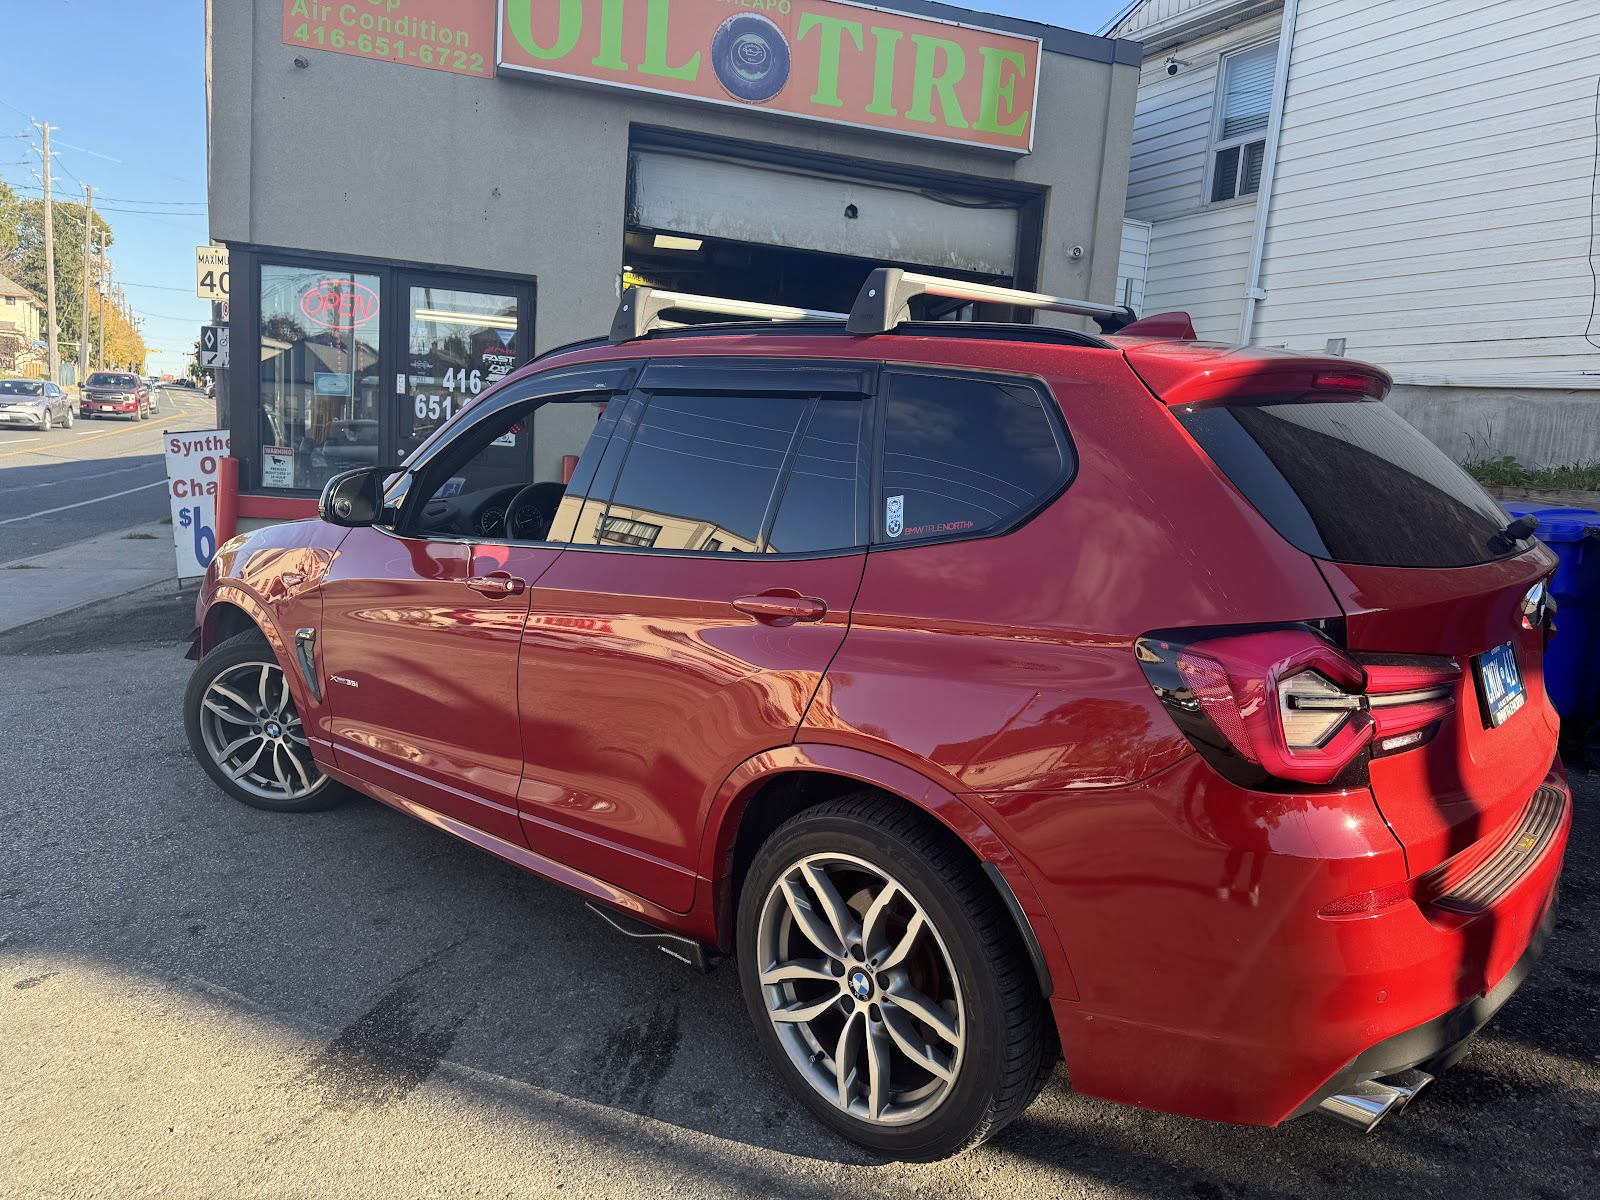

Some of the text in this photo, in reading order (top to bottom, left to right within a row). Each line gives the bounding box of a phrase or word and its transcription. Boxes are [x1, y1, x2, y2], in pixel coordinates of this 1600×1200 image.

[714, 0, 791, 15] EAPO
[290, 0, 470, 48] Air Condition
[293, 23, 485, 73] 416-651-6722
[507, 0, 1030, 137] OIL TIRE
[305, 291, 373, 318] OPEN
[482, 354, 516, 363] FAST
[442, 367, 482, 395] 416
[264, 447, 293, 456] WARNING
